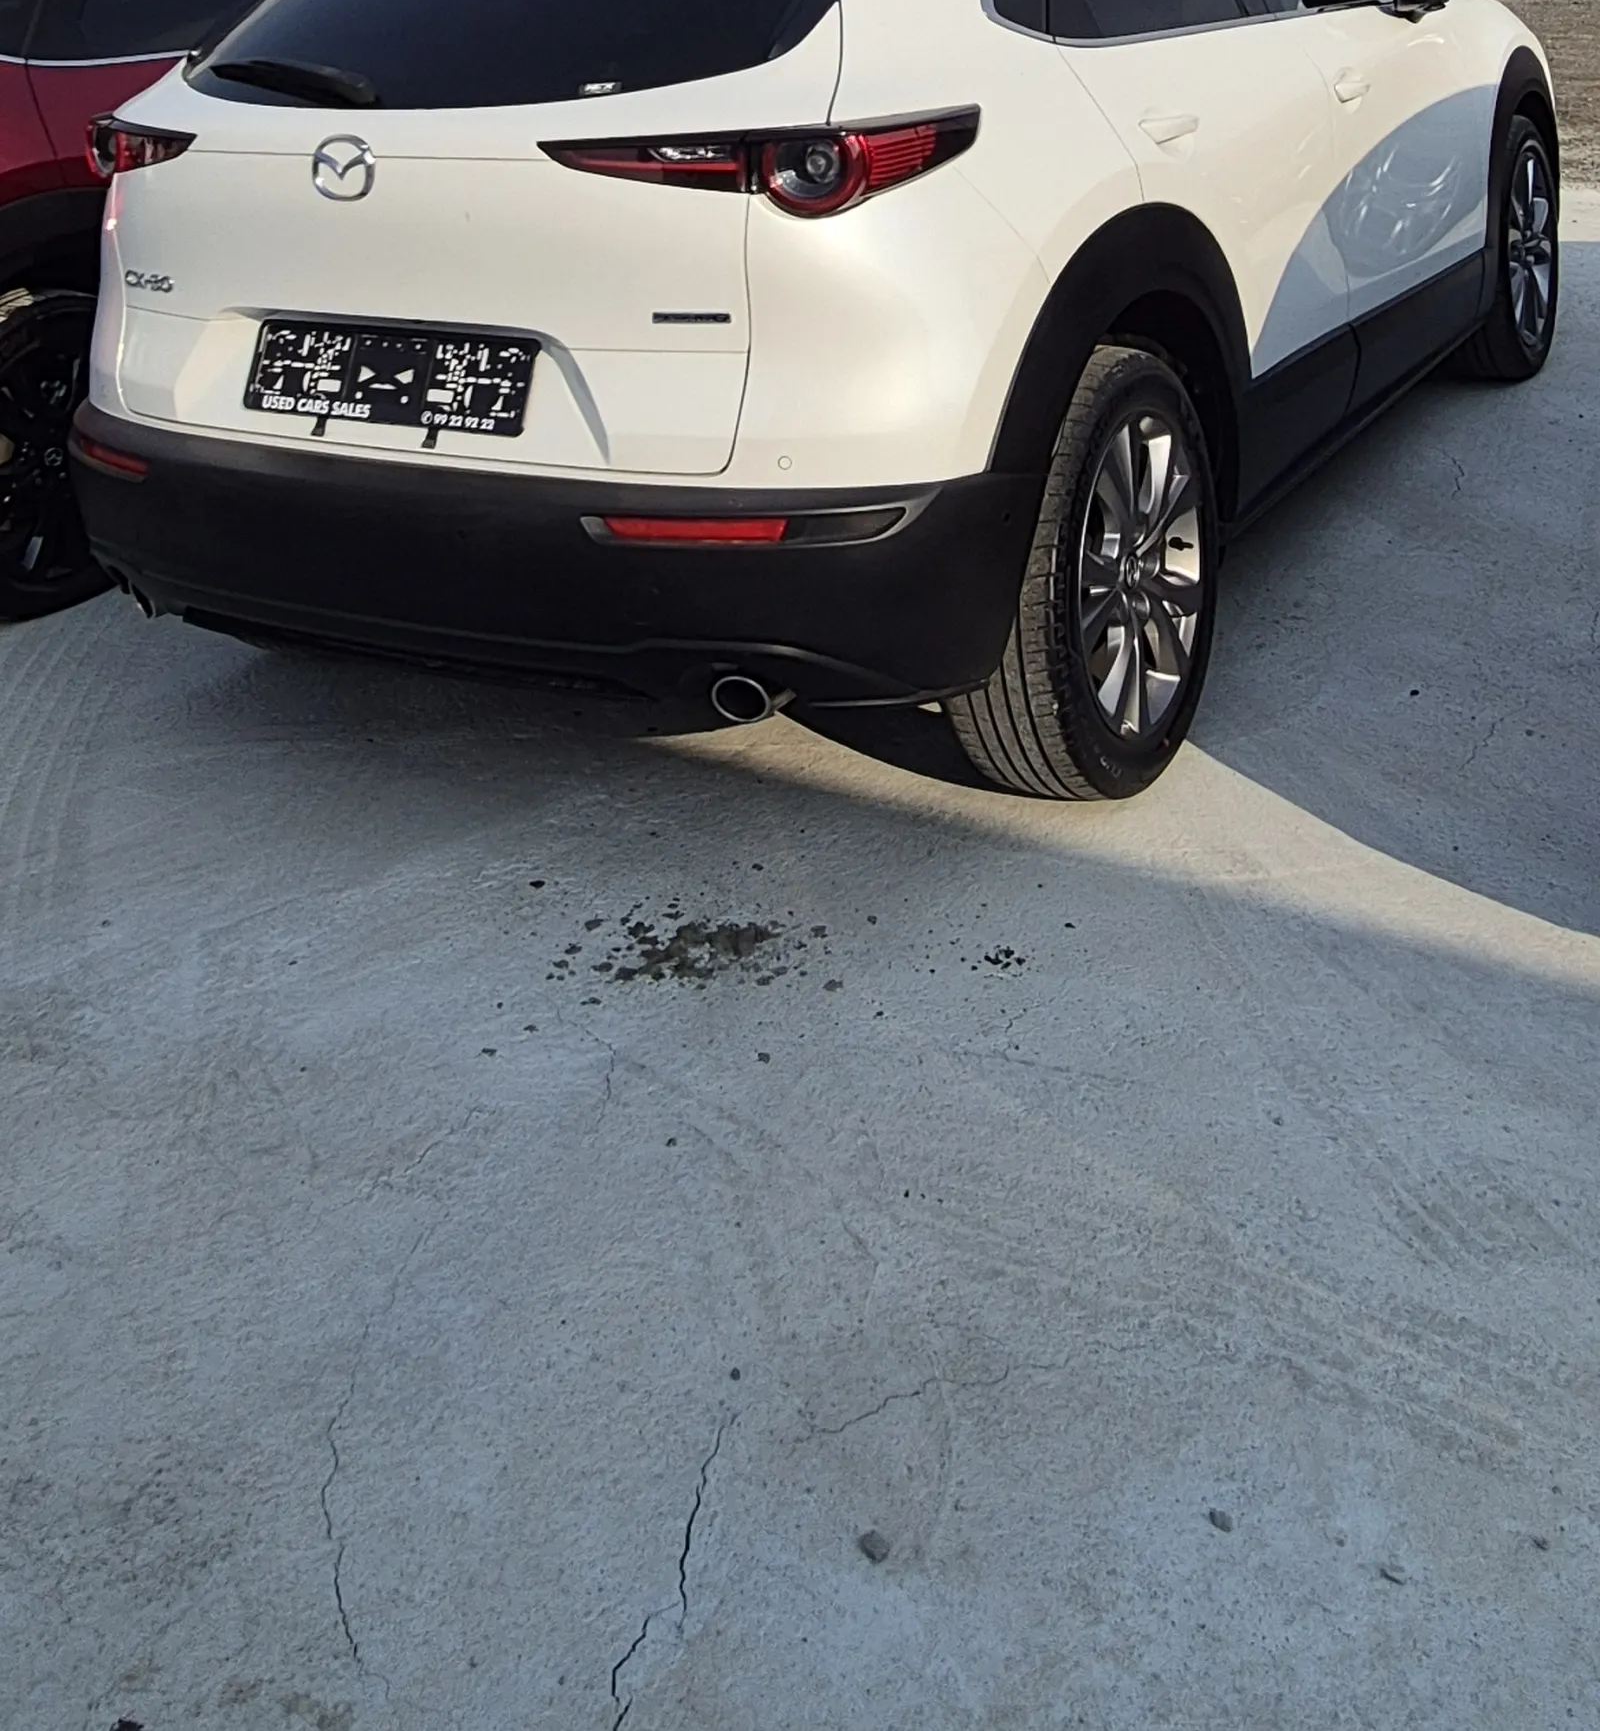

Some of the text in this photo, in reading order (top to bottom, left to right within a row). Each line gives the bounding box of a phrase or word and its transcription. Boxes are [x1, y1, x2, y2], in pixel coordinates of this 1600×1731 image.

[261, 394, 372, 418] USED CARS SALES
[433, 413, 495, 431] 99 22 92 22
